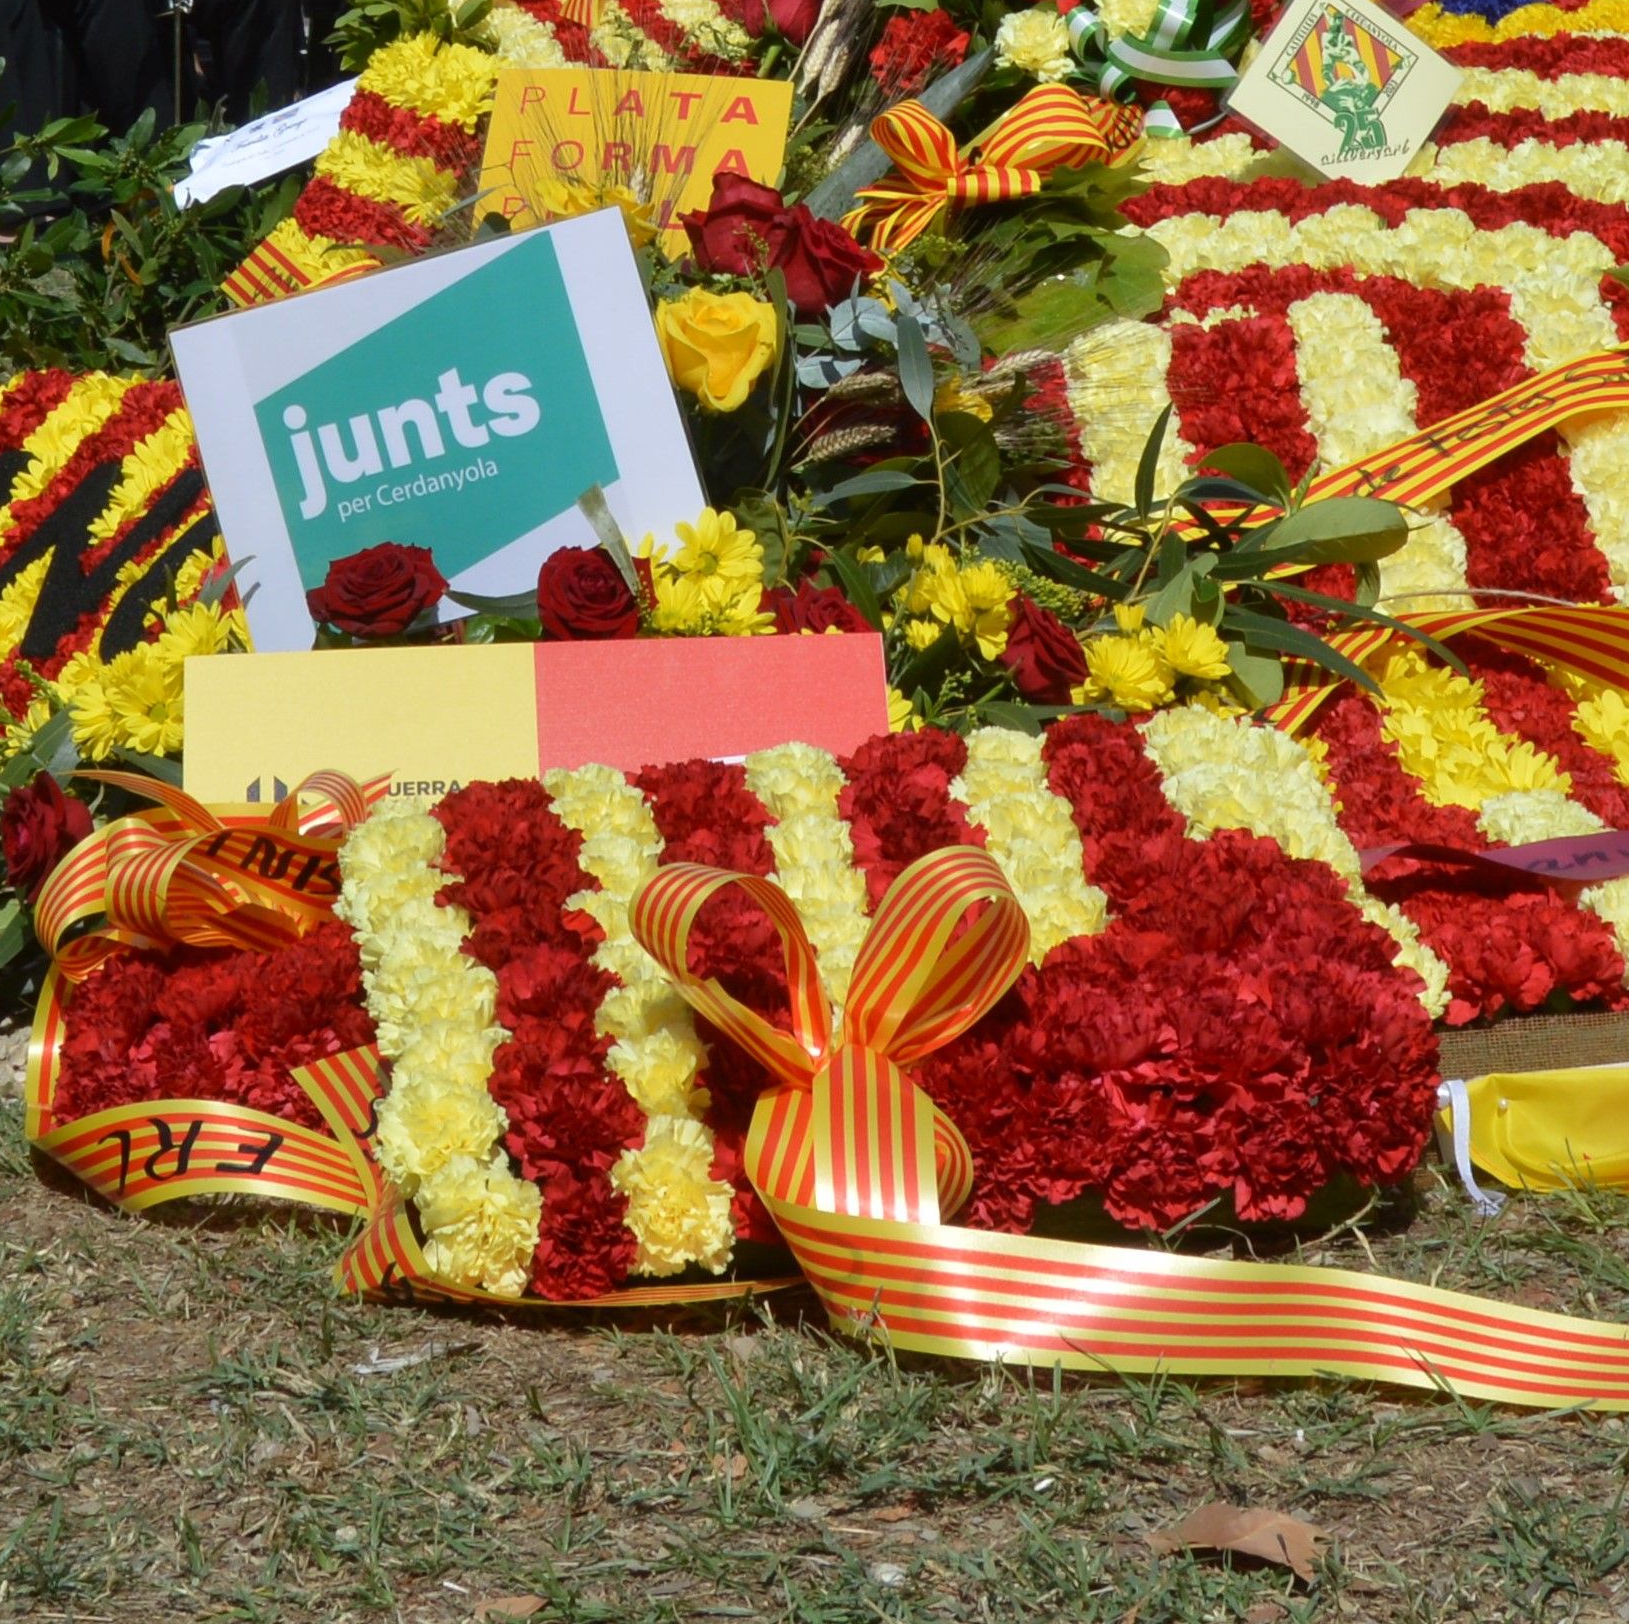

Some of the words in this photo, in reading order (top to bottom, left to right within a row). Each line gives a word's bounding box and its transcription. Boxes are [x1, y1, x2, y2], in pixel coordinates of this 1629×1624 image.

[1345, 8, 1399, 51] CERDANYOLA
[520, 86, 759, 126] PLATA
[1334, 107, 1387, 155] 25
[508, 140, 750, 178] FORMA
[283, 367, 541, 520] junts
[337, 494, 372, 523] per
[376, 458, 498, 506] Cerdanyola
[388, 779, 462, 797] UERRA
